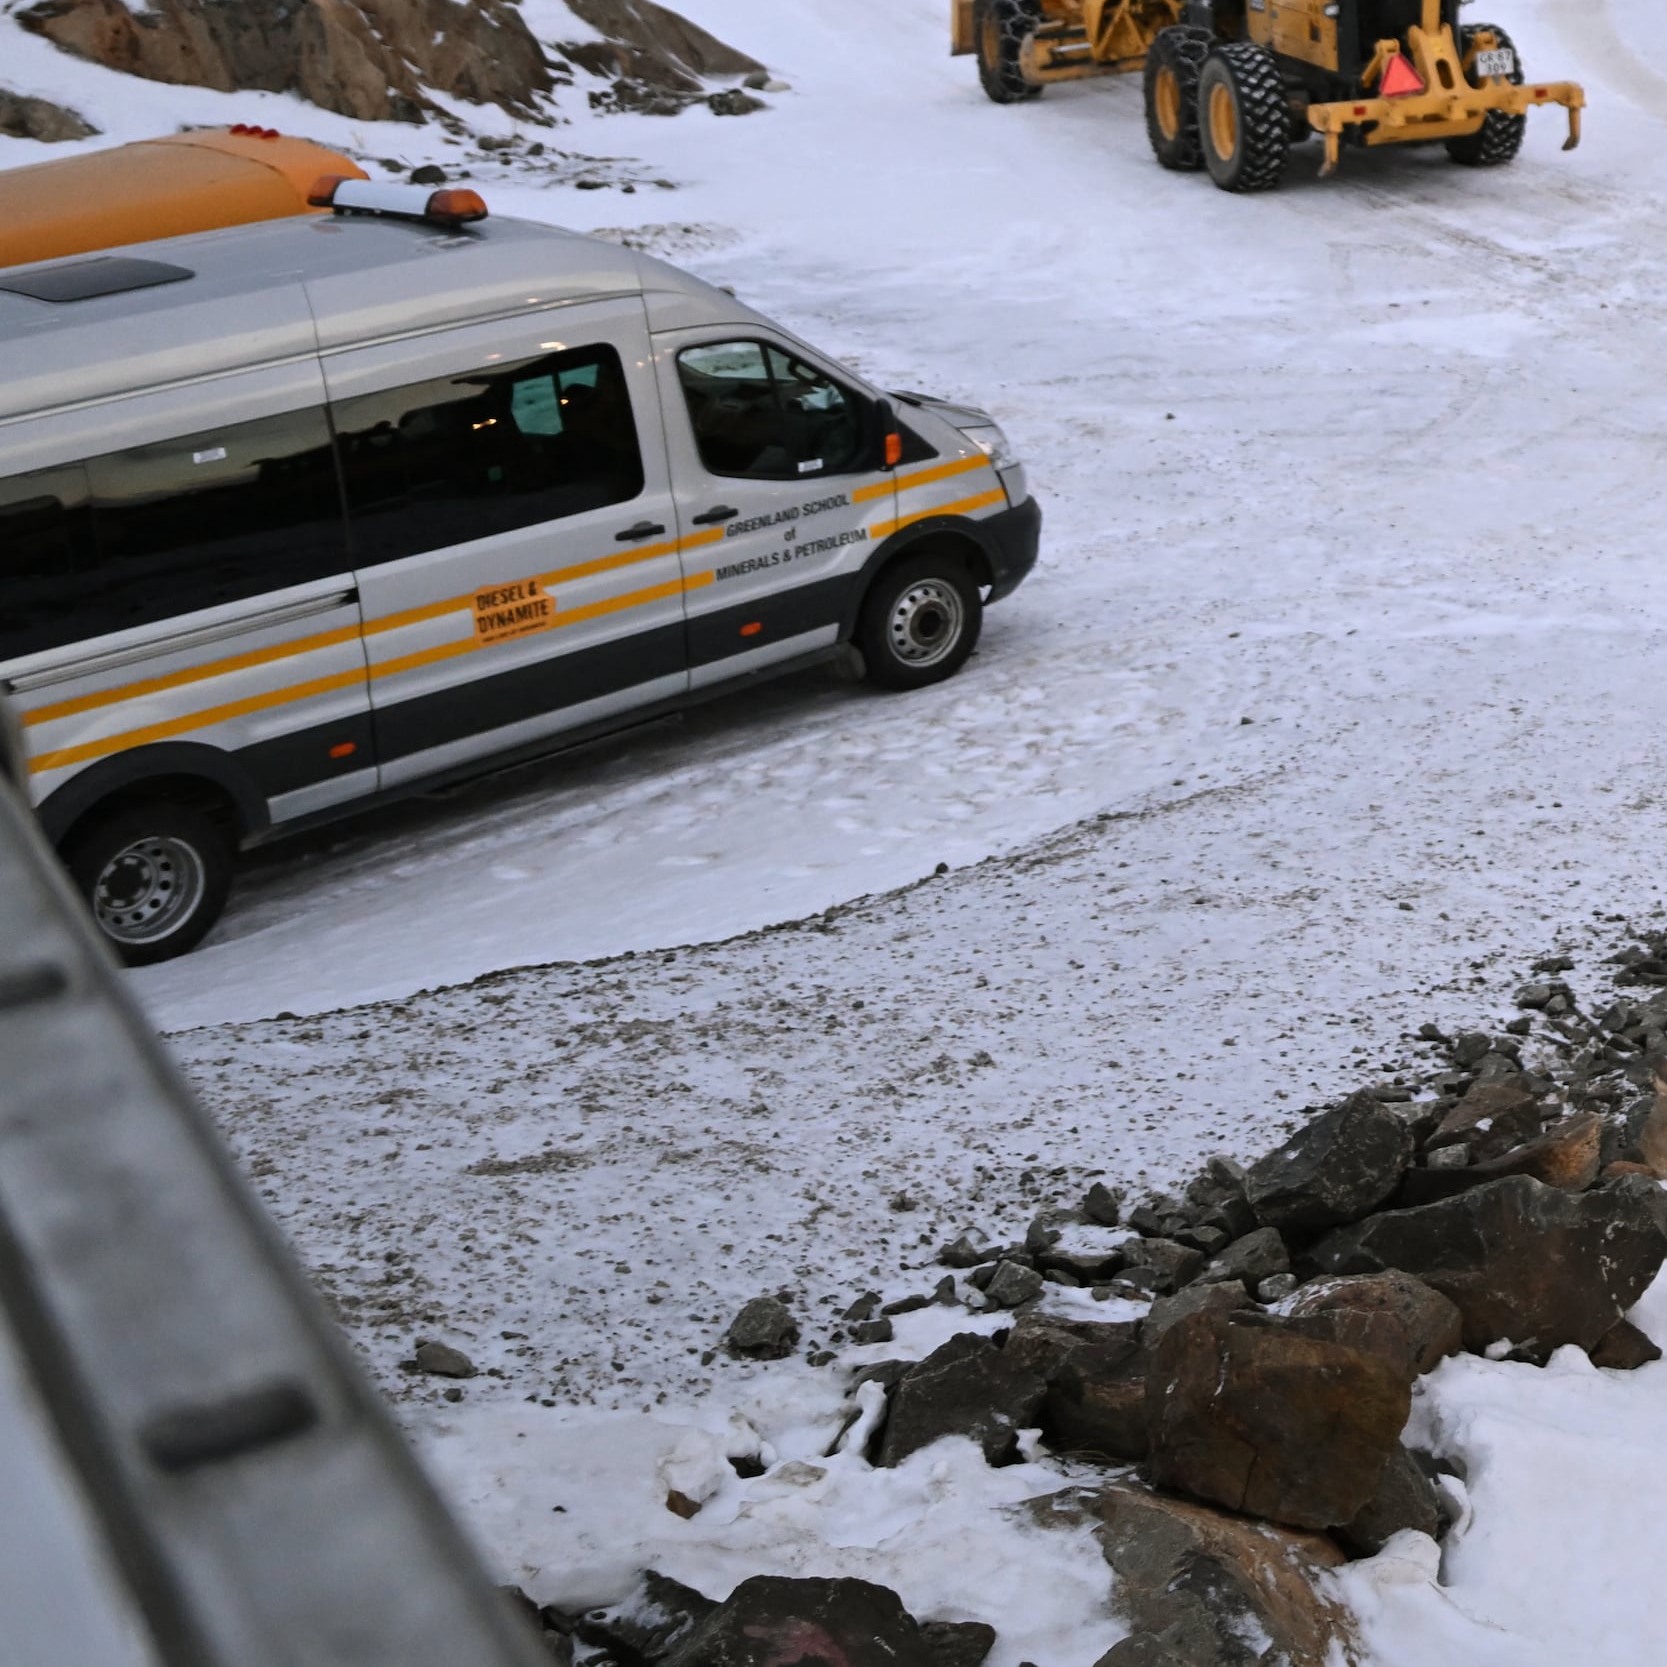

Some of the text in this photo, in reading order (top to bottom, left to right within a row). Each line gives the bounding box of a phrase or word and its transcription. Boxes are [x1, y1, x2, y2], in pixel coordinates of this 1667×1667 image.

[727, 494, 850, 536] GREENLAND SCHOOL
[784, 527, 796, 541] of
[716, 528, 868, 581] MINERALS & PETROLEUM
[476, 585, 524, 611] DIESEL
[478, 598, 549, 633] DYNAMITE
